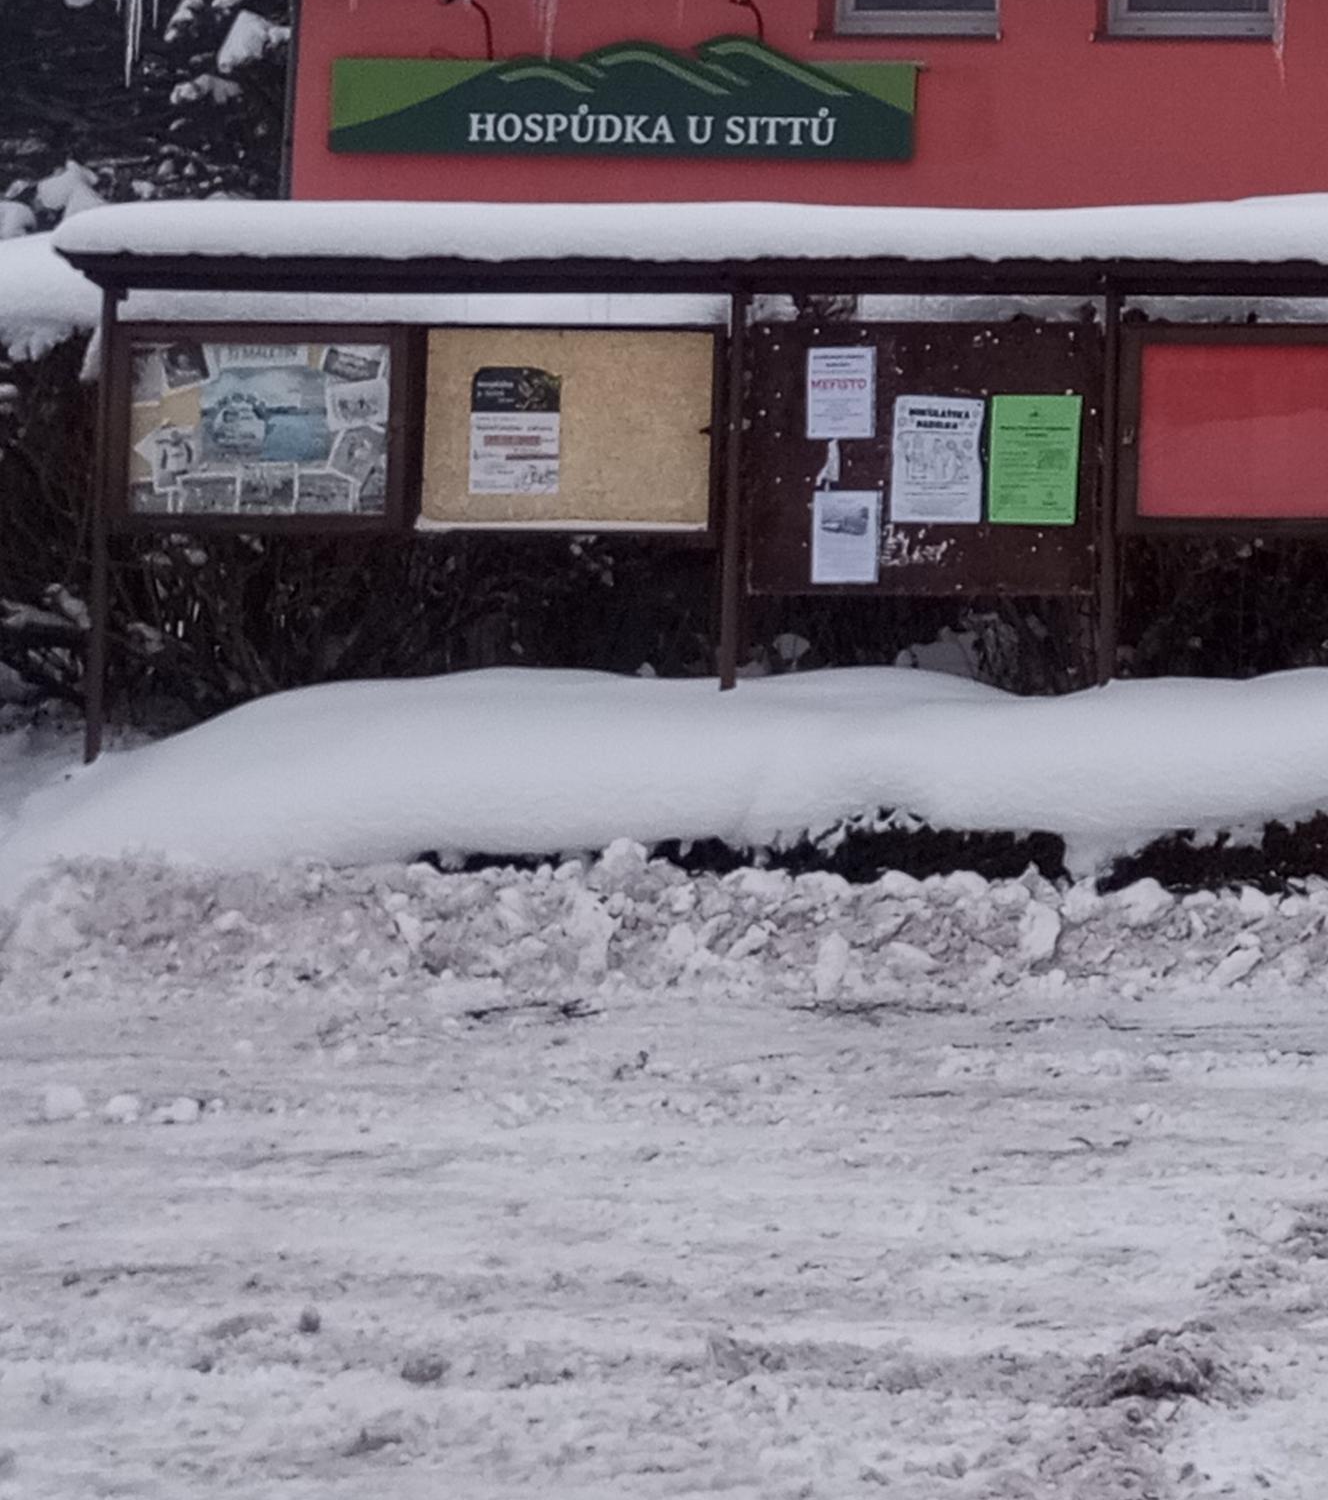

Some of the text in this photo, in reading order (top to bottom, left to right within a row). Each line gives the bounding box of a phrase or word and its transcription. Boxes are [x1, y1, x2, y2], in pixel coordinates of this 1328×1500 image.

[467, 103, 836, 146] HOSPŮDKA U SITTŮ
